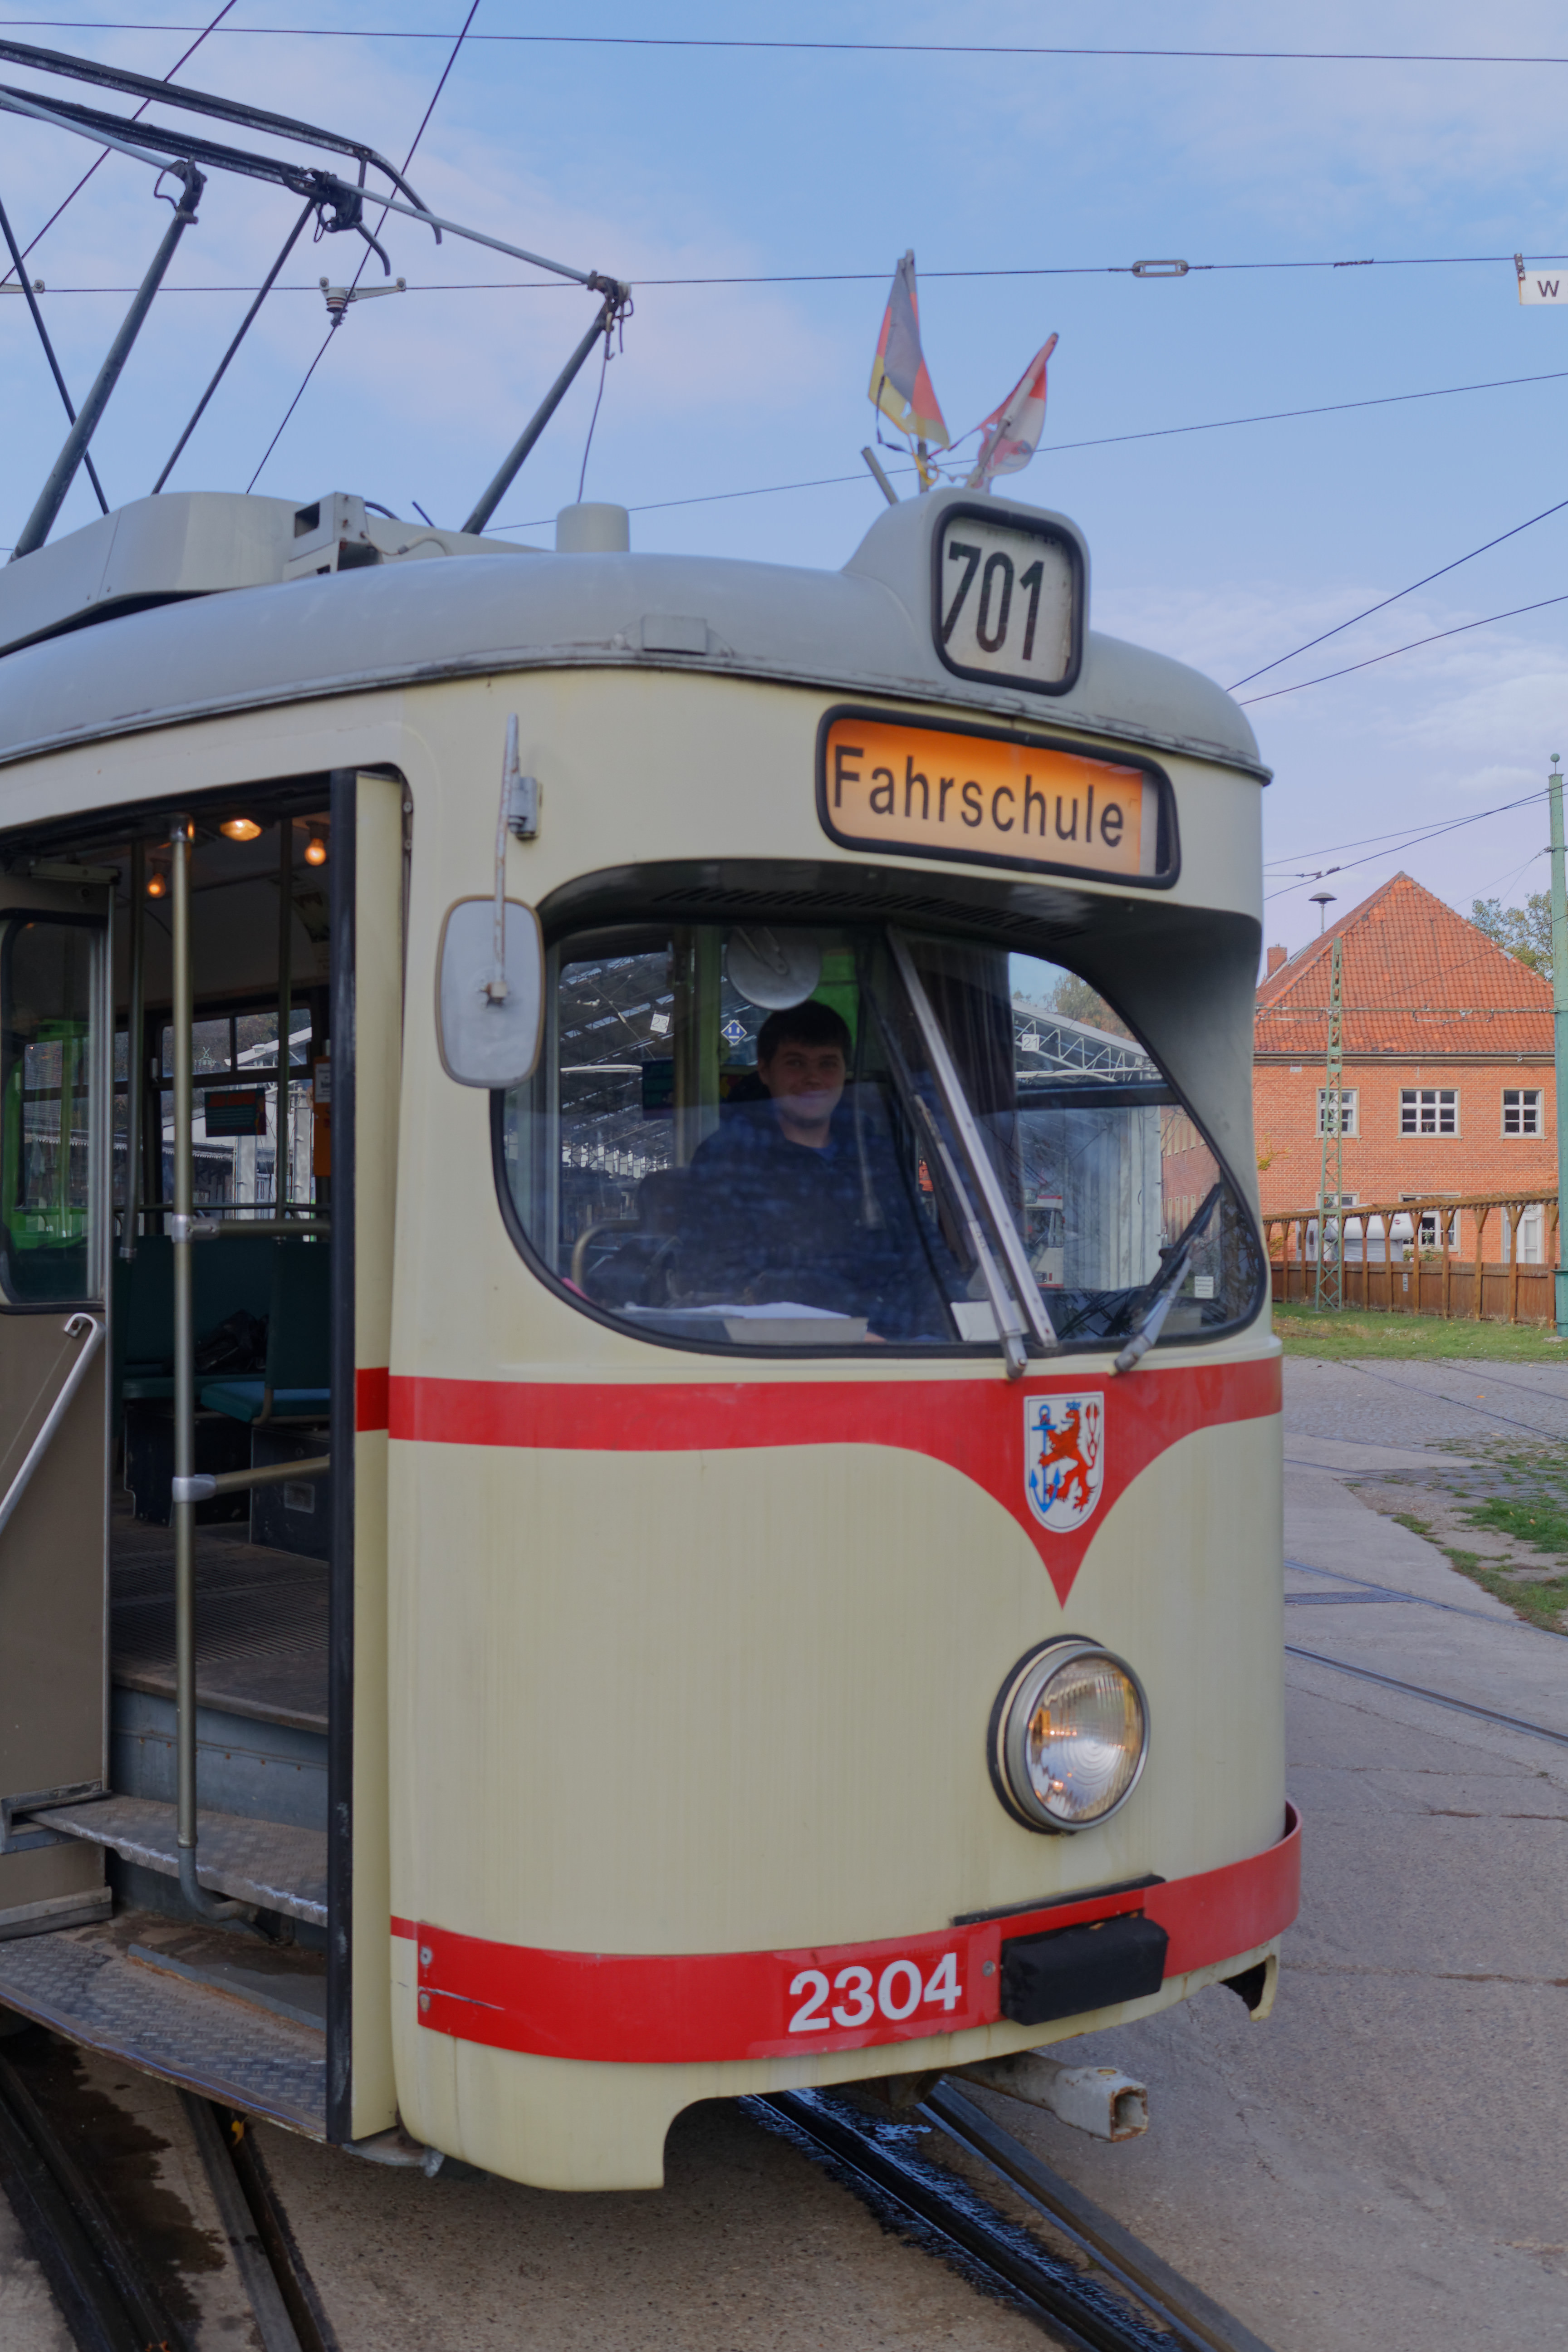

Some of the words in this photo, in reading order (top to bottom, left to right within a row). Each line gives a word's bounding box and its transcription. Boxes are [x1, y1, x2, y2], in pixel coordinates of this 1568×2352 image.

[942, 540, 1044, 661] 701
[833, 744, 1124, 848] Fahrschule
[652, 1016, 667, 1029] 23
[1024, 1037, 1038, 1049] 21
[788, 1952, 962, 2033] 2304
